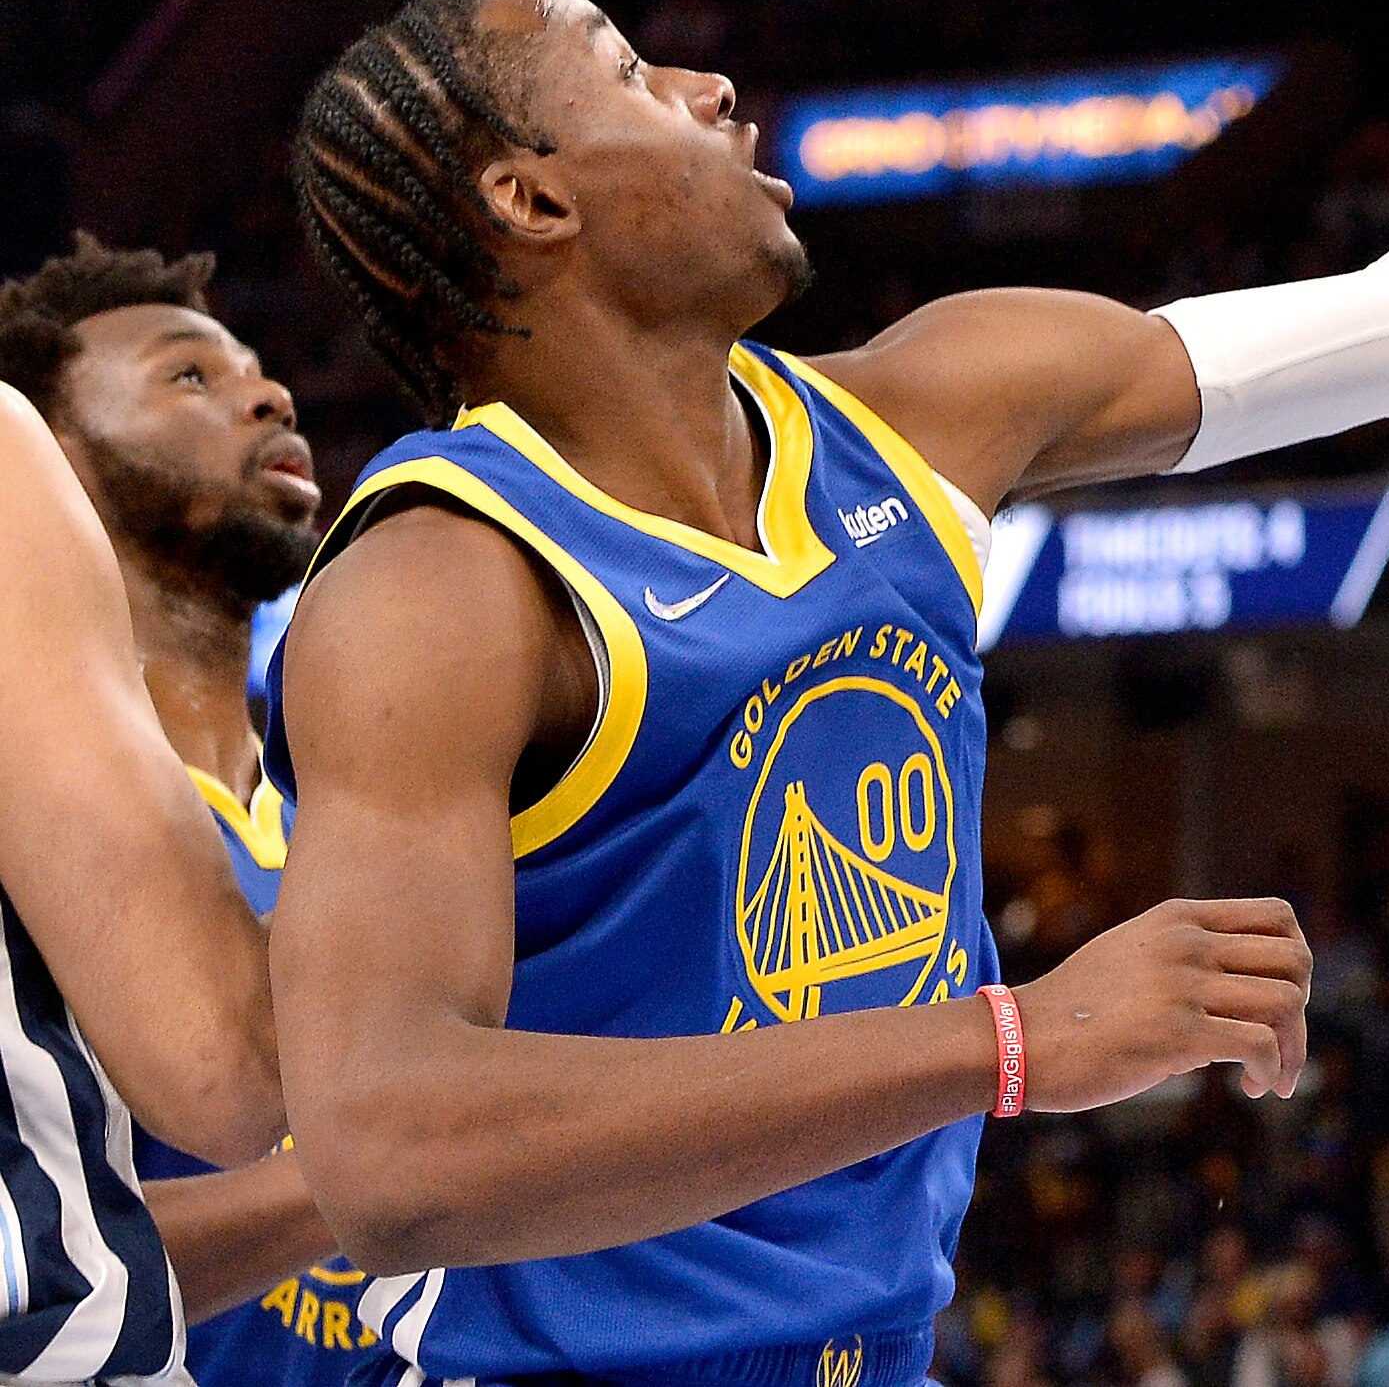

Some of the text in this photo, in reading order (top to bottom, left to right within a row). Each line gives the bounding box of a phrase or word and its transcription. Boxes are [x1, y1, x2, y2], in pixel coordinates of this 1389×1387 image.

[730, 624, 962, 770] GOLDEN STATE
[856, 752, 938, 863] 00
[999, 1002, 1023, 1112] #PlayGigisWay
